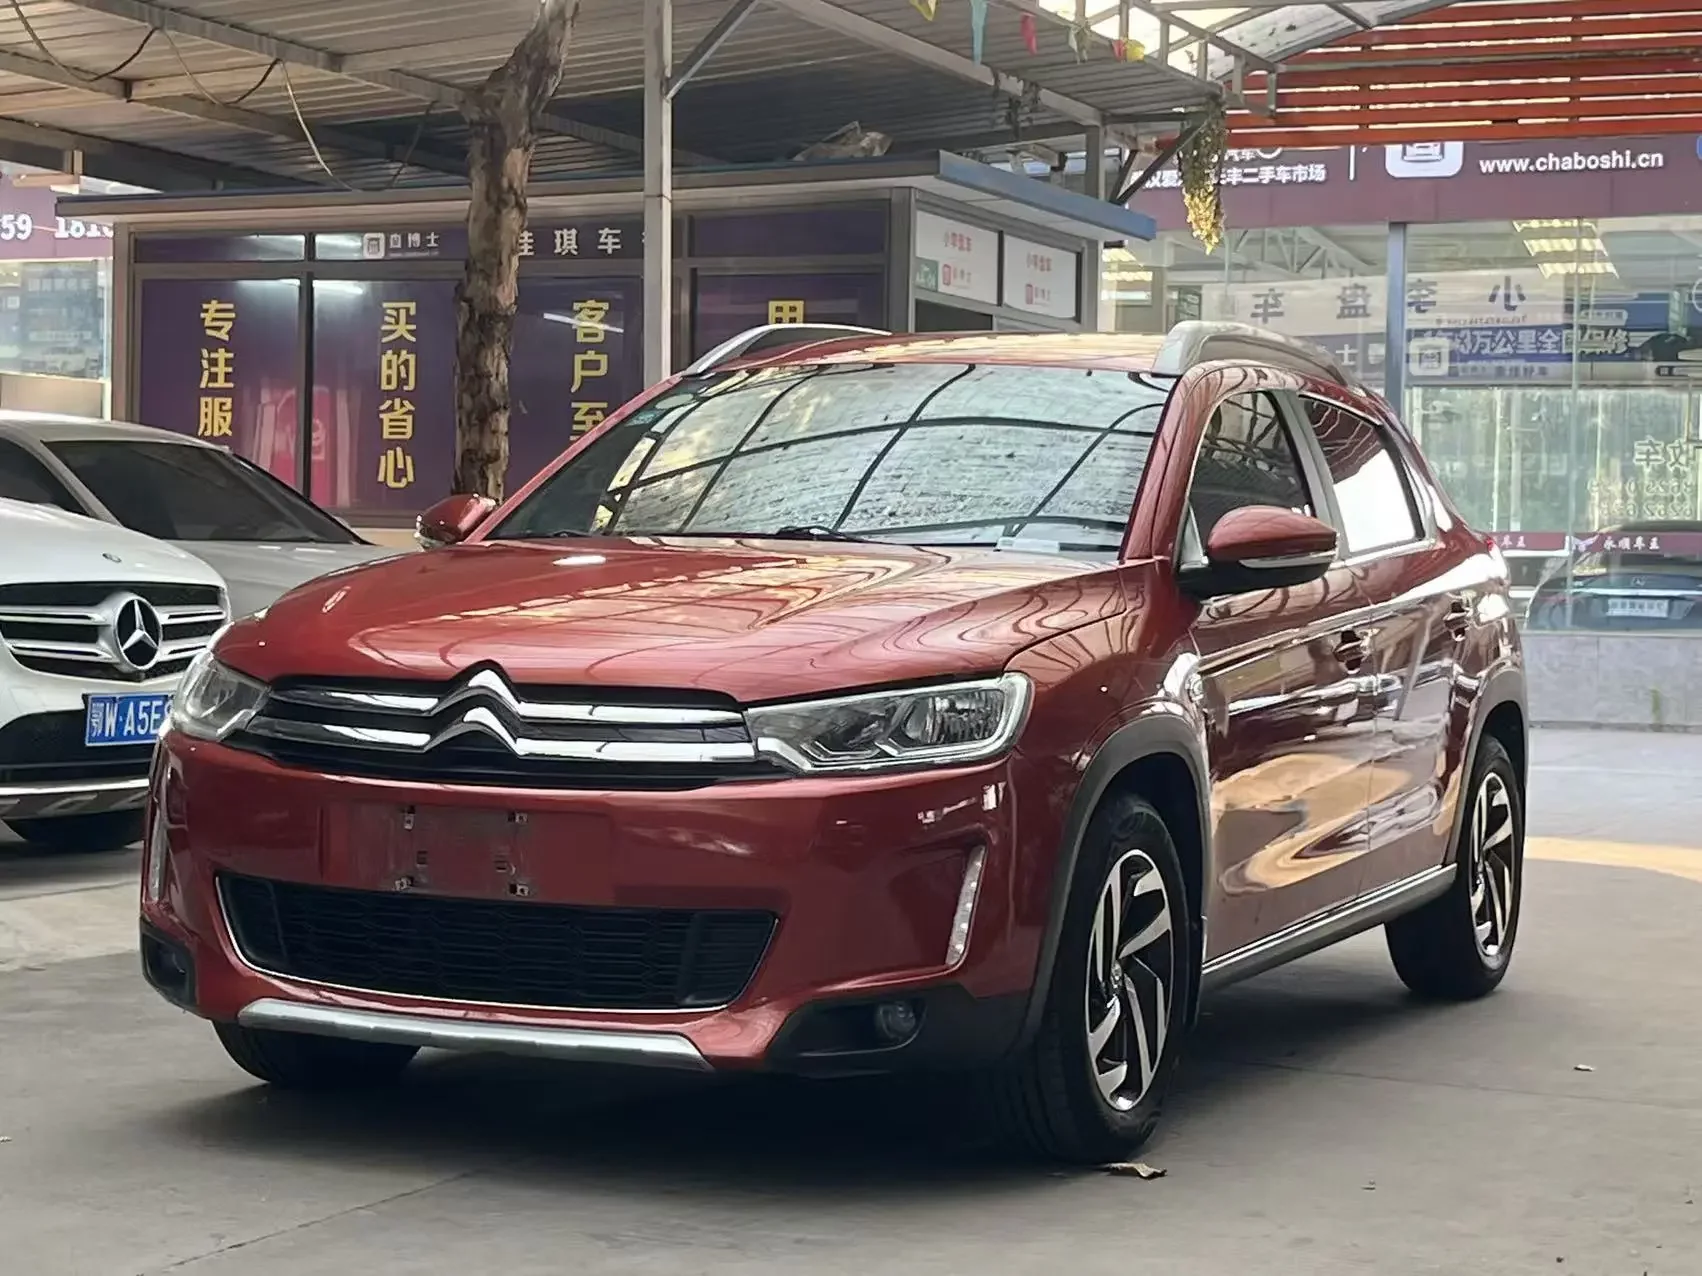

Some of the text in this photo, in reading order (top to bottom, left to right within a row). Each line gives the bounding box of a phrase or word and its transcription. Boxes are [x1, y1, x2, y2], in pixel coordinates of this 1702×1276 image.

[1479, 150, 1664, 174] www.chaboshi.cn
[198, 300, 236, 450] 专注服
[377, 301, 418, 490] 买的省心
